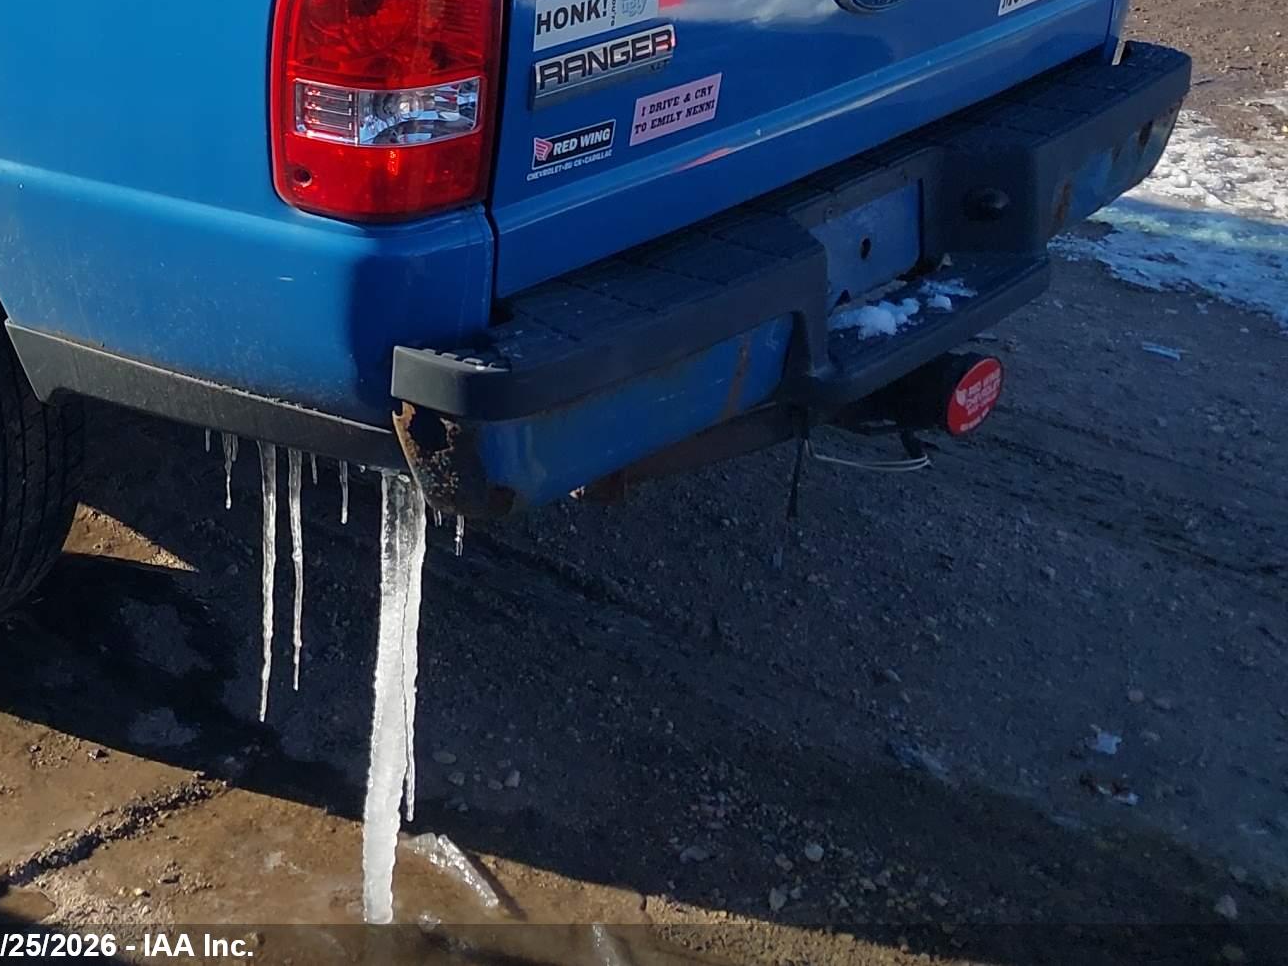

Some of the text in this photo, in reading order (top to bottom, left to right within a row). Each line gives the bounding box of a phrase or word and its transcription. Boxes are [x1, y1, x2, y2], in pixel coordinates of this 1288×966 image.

[539, 29, 672, 90] RANGER
[634, 99, 715, 134] TO EMILY NENNI
[641, 85, 713, 117] I DRIVE & CRY
[553, 128, 611, 155] RED WING
